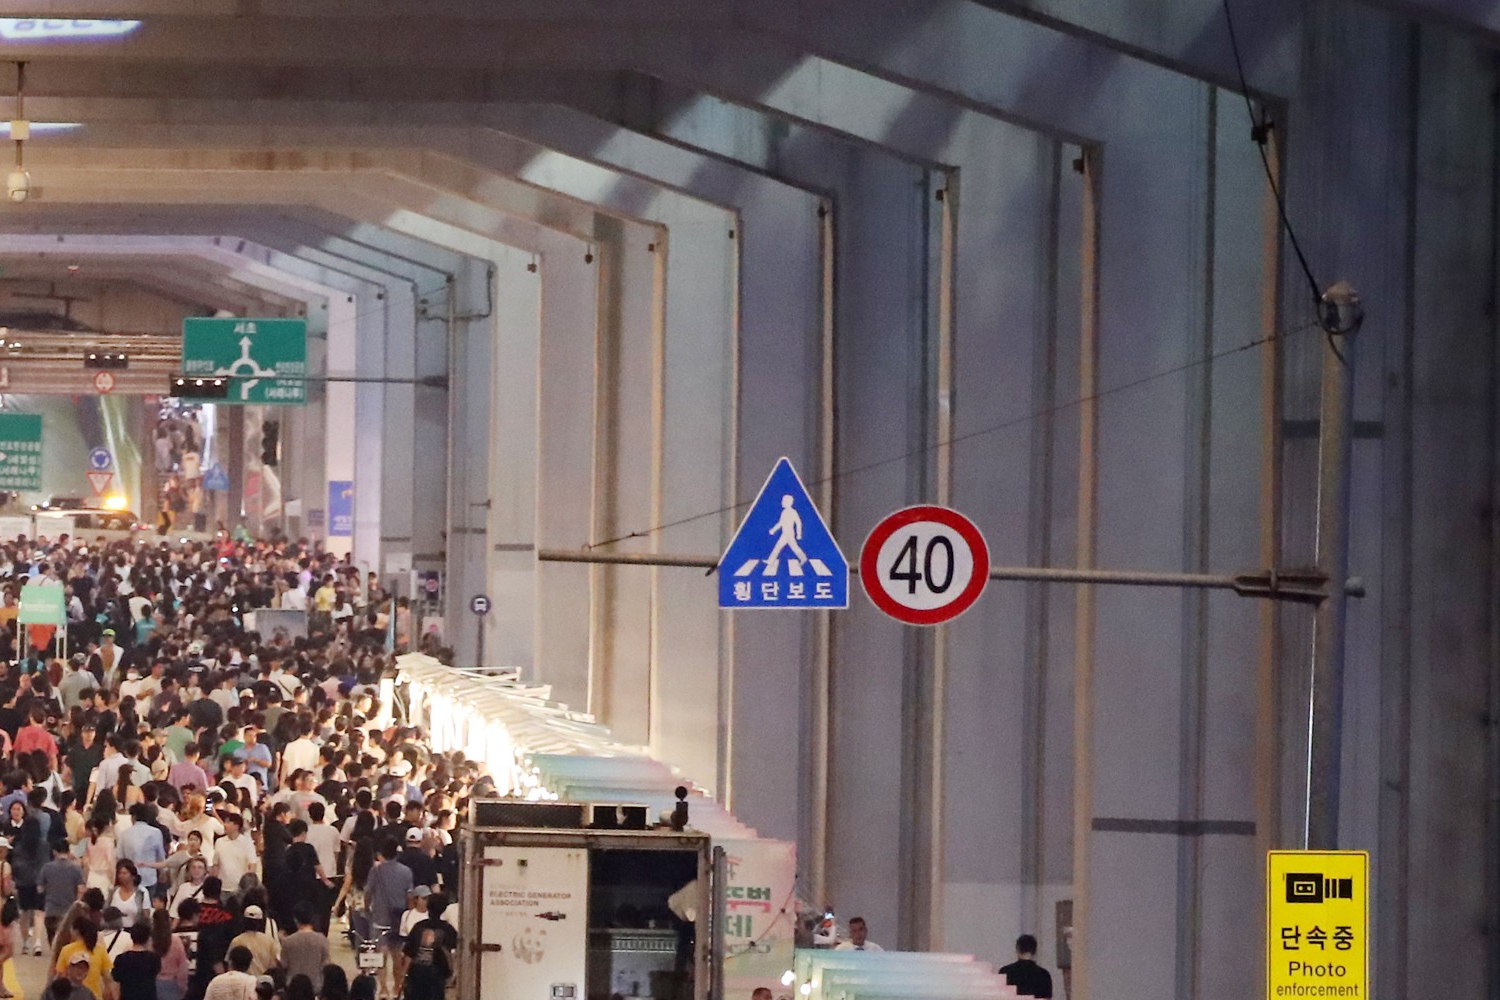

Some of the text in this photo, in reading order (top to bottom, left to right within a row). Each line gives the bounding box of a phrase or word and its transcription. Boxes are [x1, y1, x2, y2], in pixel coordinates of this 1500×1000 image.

[889, 535, 955, 594] 40
[733, 582, 833, 601] 횡단보도
[489, 890, 572, 900] ELECTRIC GENERATOR
[1281, 925, 1354, 951] 단속중
[1288, 961, 1347, 977] Photo
[1276, 982, 1359, 997] enforcement
